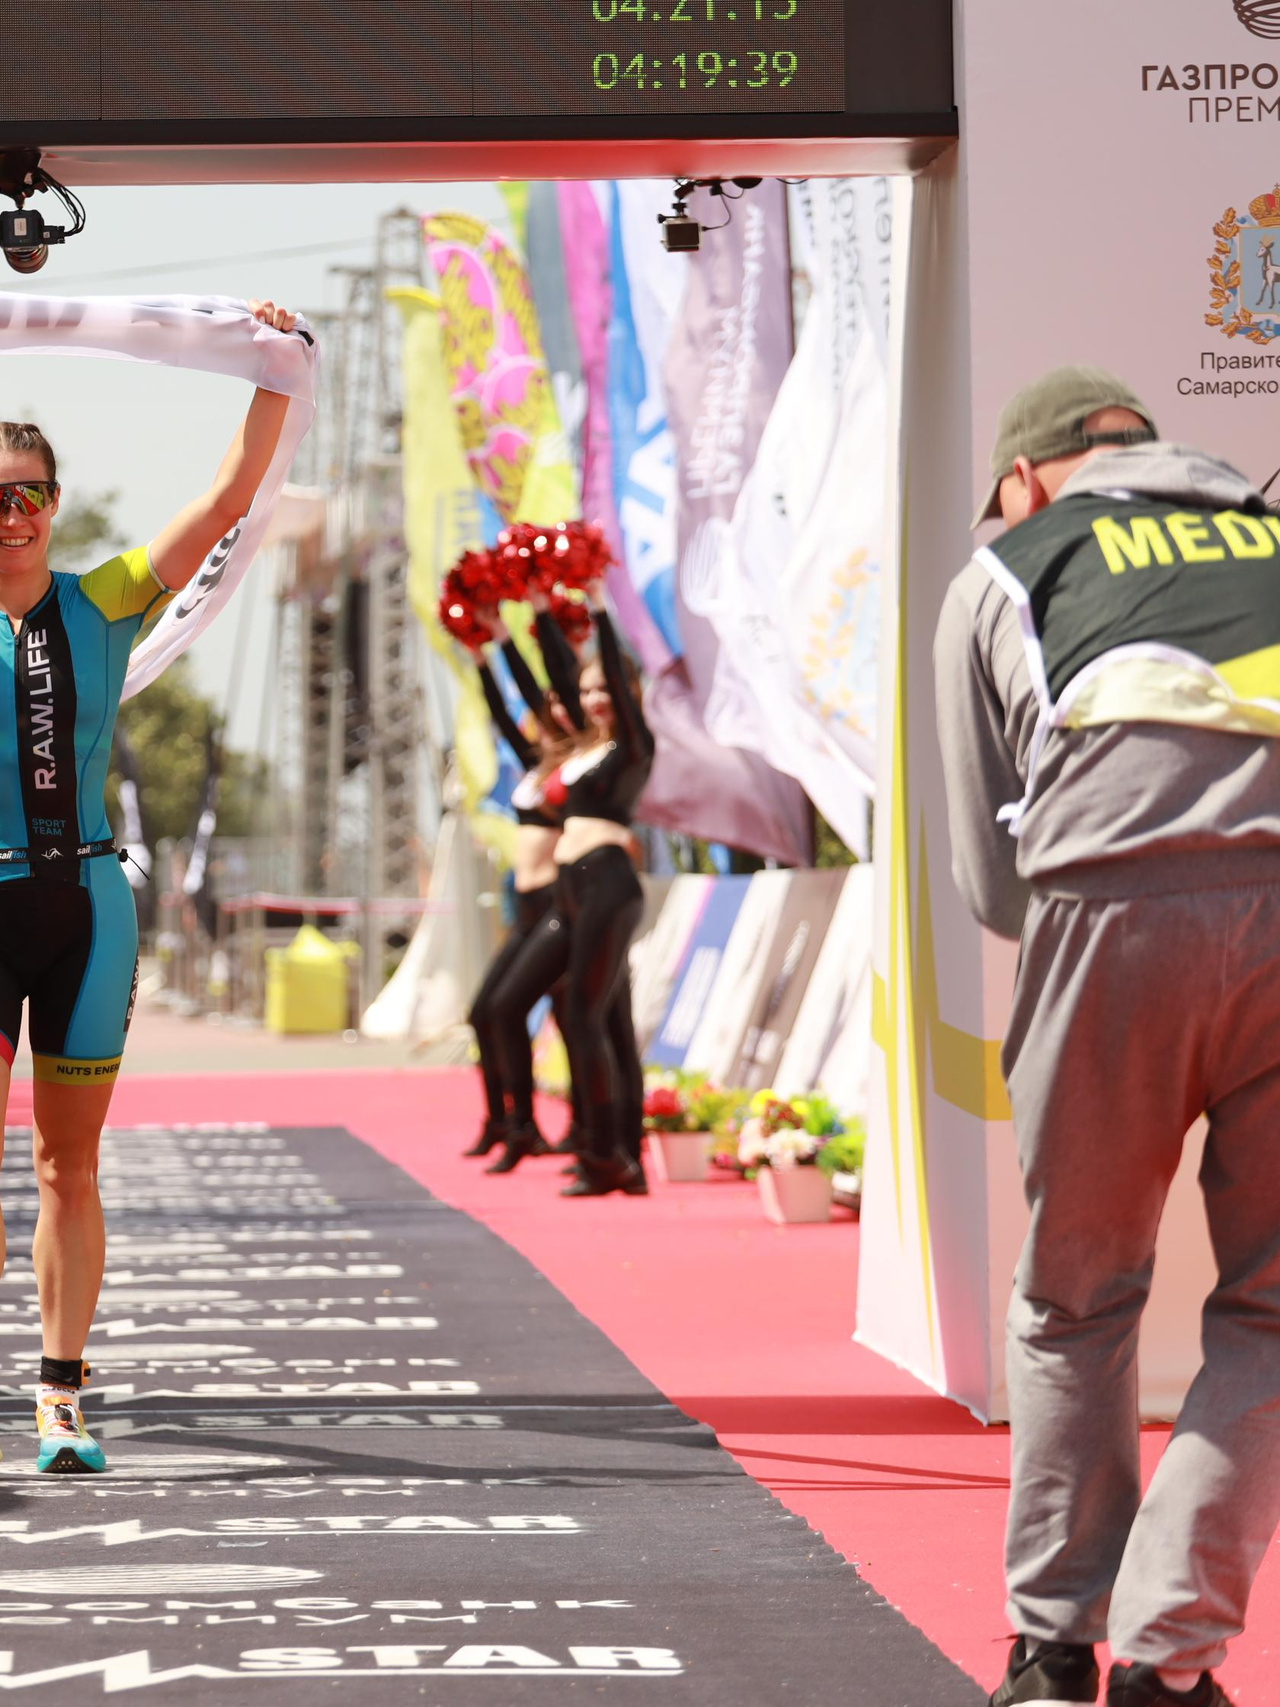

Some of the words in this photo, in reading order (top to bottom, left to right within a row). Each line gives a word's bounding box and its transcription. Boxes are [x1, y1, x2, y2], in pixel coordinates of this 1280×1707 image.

[592, 51, 798, 89] 04:19:39
[1141, 63, 1279, 91] ГАЗПРО
[1188, 97, 1280, 123] ПРЕМ
[1177, 377, 1279, 398] Самарско
[27, 628, 57, 790] R.A.W.LIFE
[32, 818, 66, 829] SPORT
[32, 826, 63, 836] TEAM
[56, 1064, 92, 1076] NUTS
[215, 1516, 580, 1530] STAR
[238, 1645, 684, 1669] STAR
